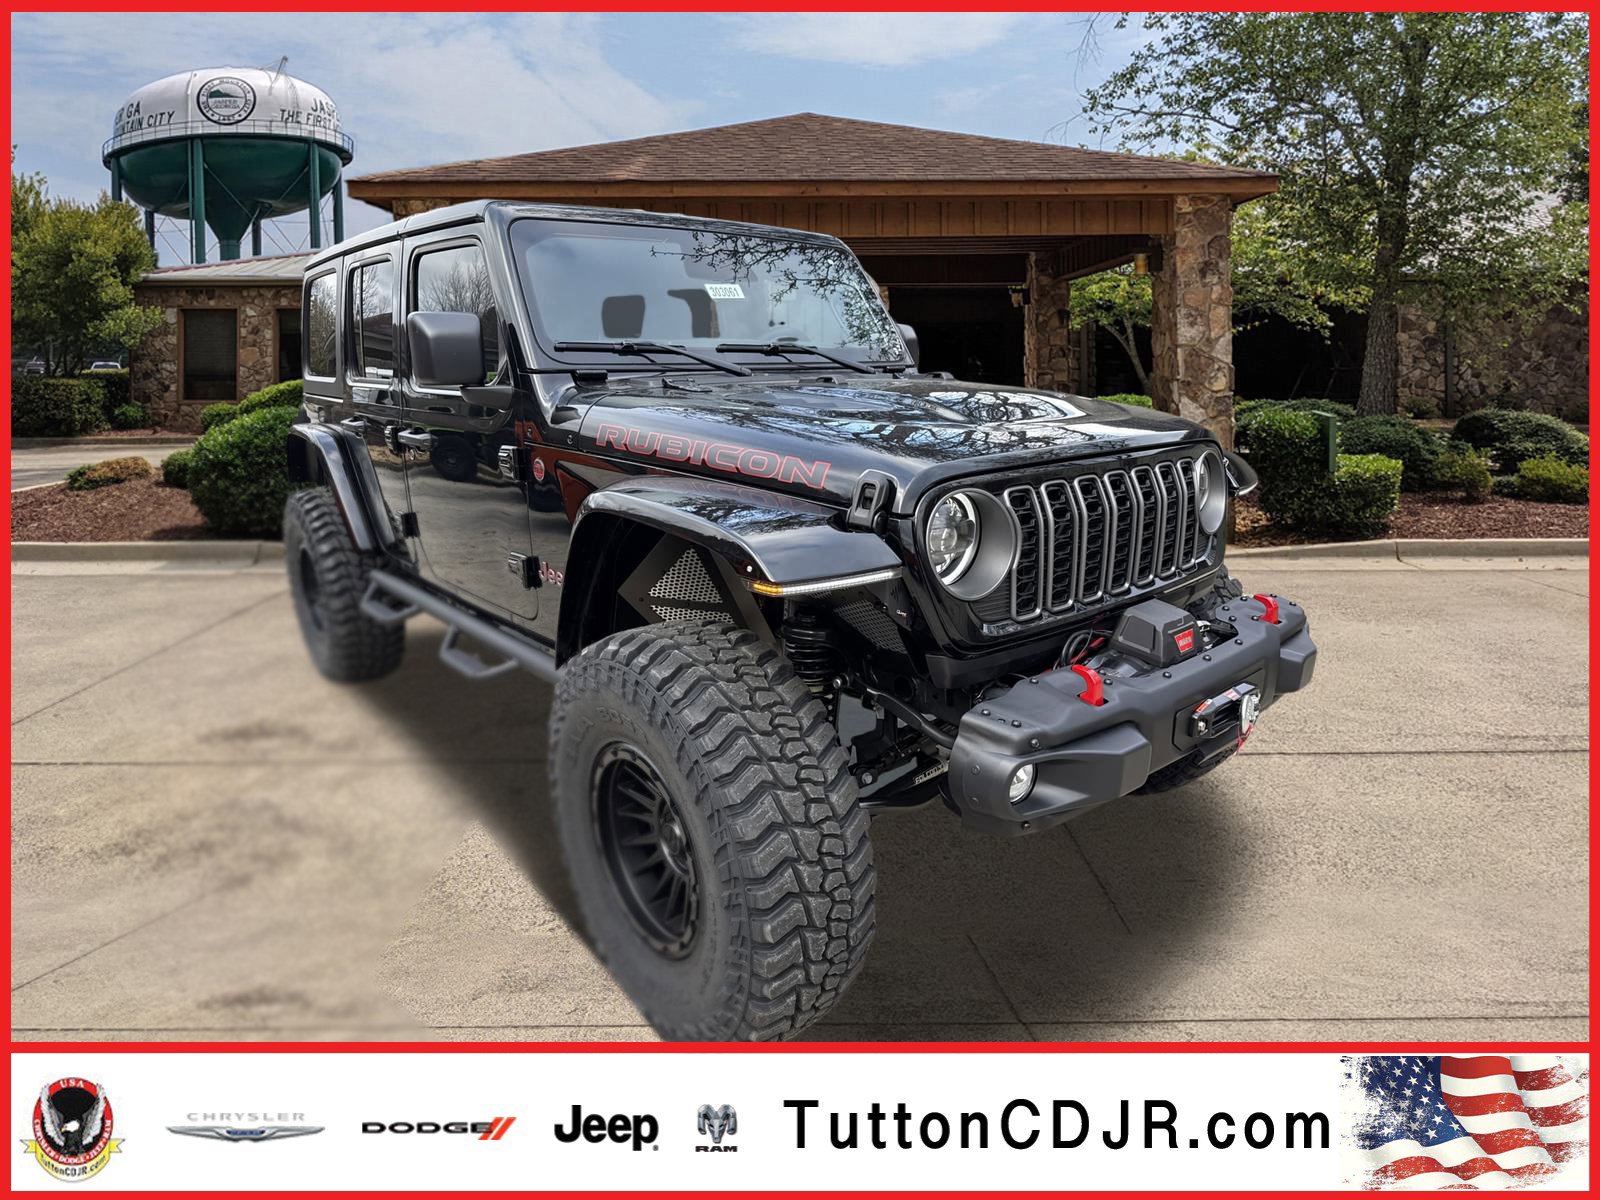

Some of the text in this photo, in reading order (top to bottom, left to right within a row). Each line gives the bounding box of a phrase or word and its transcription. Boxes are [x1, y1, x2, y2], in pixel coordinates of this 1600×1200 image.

[126, 101, 141, 119] GA
[147, 110, 176, 127] CITY
[279, 108, 302, 123] THE
[306, 112, 332, 129] FIRST
[709, 286, 740, 297] 303061
[596, 423, 832, 489] RUBICON
[538, 561, 564, 585] Jee
